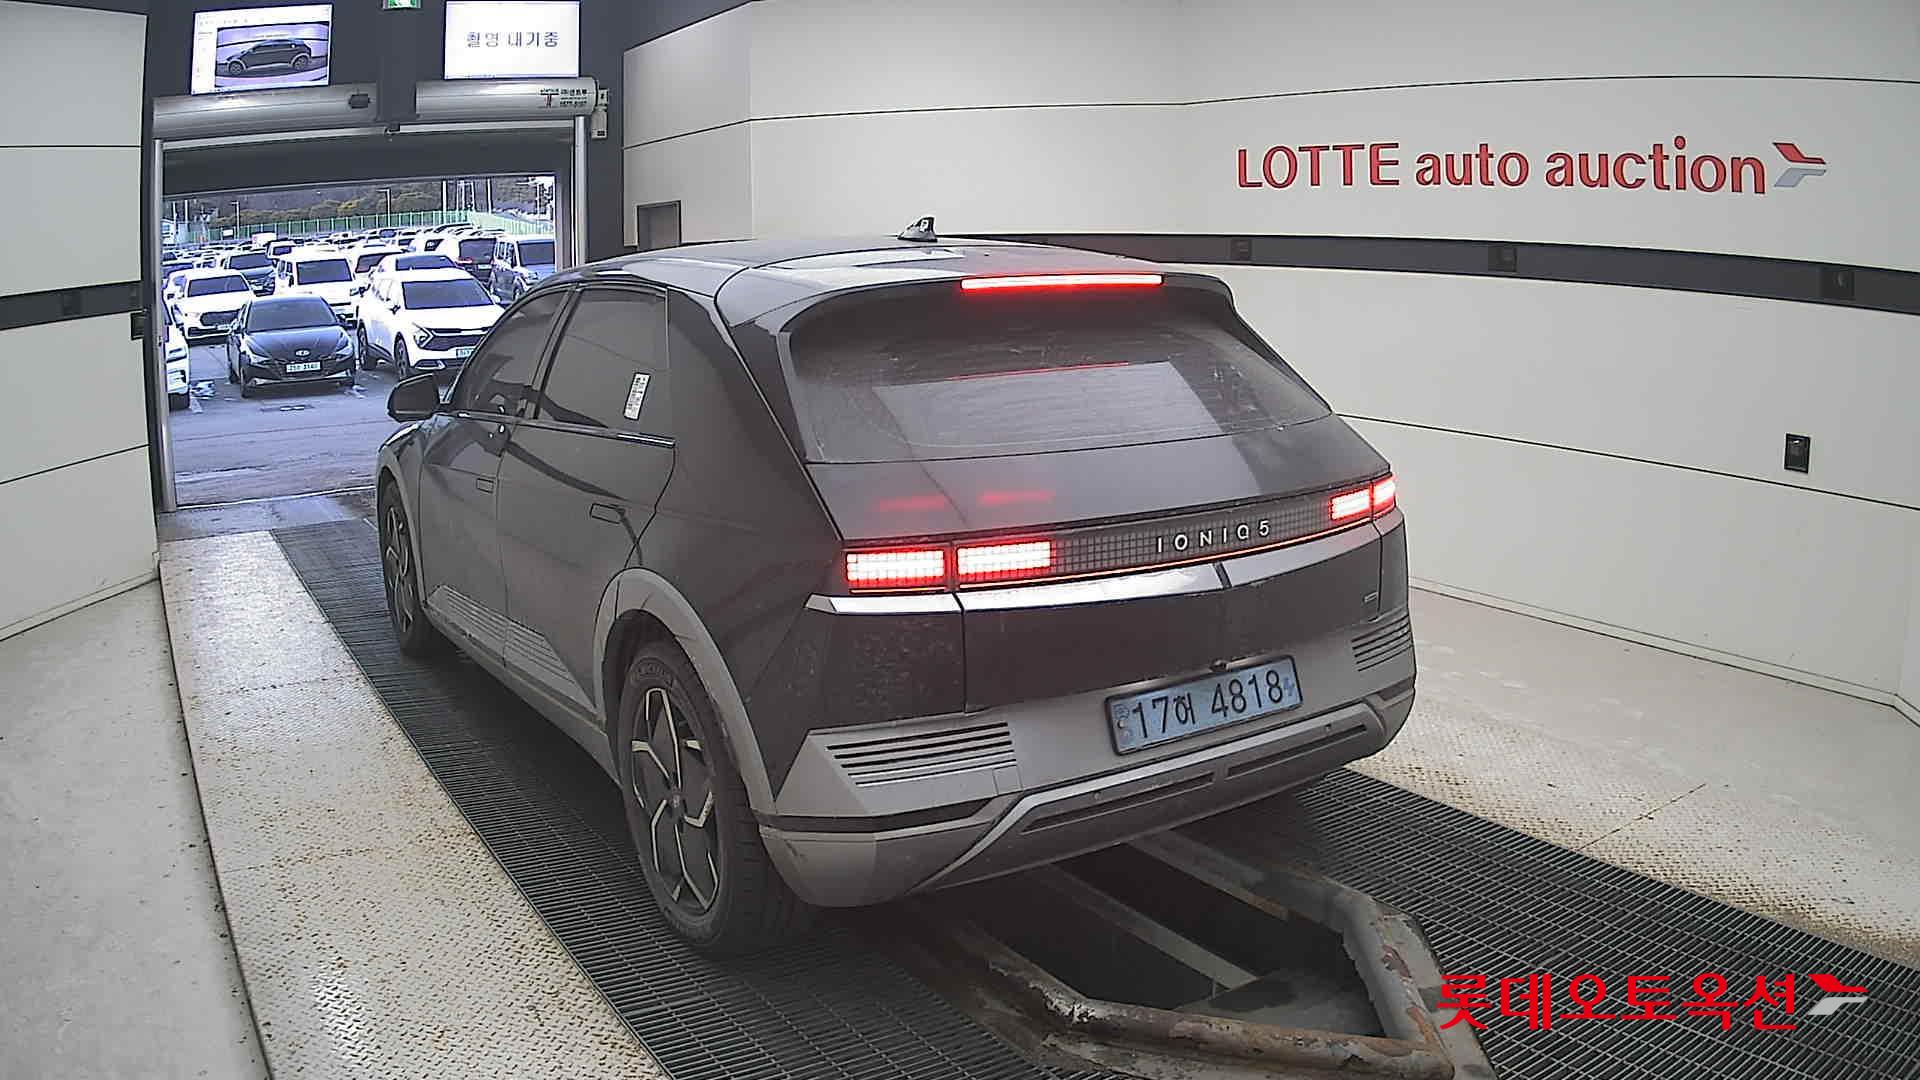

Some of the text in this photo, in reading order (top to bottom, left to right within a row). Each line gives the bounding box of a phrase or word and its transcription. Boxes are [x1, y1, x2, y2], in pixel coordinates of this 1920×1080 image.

[508, 31, 560, 48] 대기중
[1237, 136, 1766, 194] LOTTE auto auction
[1211, 669, 1284, 718] 4818
